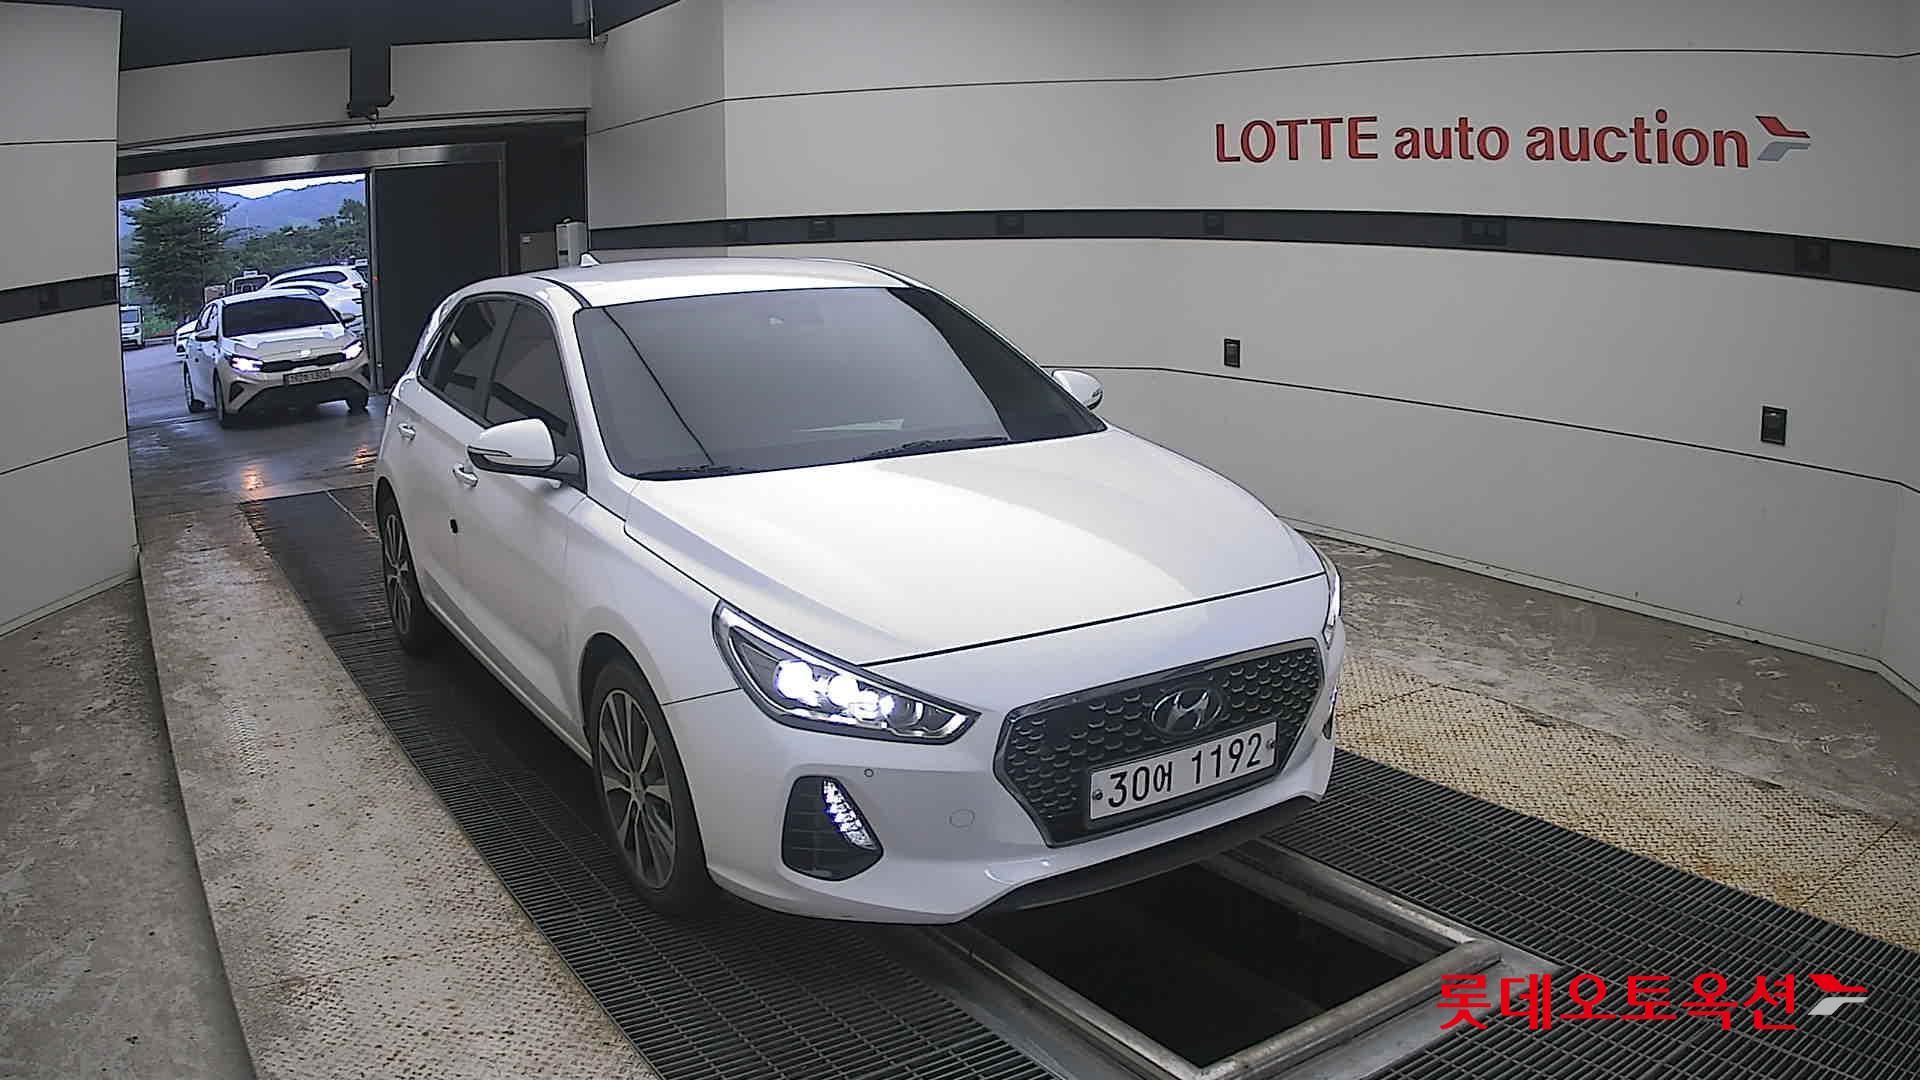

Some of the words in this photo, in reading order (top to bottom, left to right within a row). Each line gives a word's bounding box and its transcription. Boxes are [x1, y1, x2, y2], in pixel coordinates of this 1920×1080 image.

[1215, 115, 1378, 163] LOTTE
[1393, 116, 1510, 162] auto
[1525, 109, 1750, 169] auction
[1108, 761, 1173, 808] 30어
[1191, 732, 1262, 785] 1192
